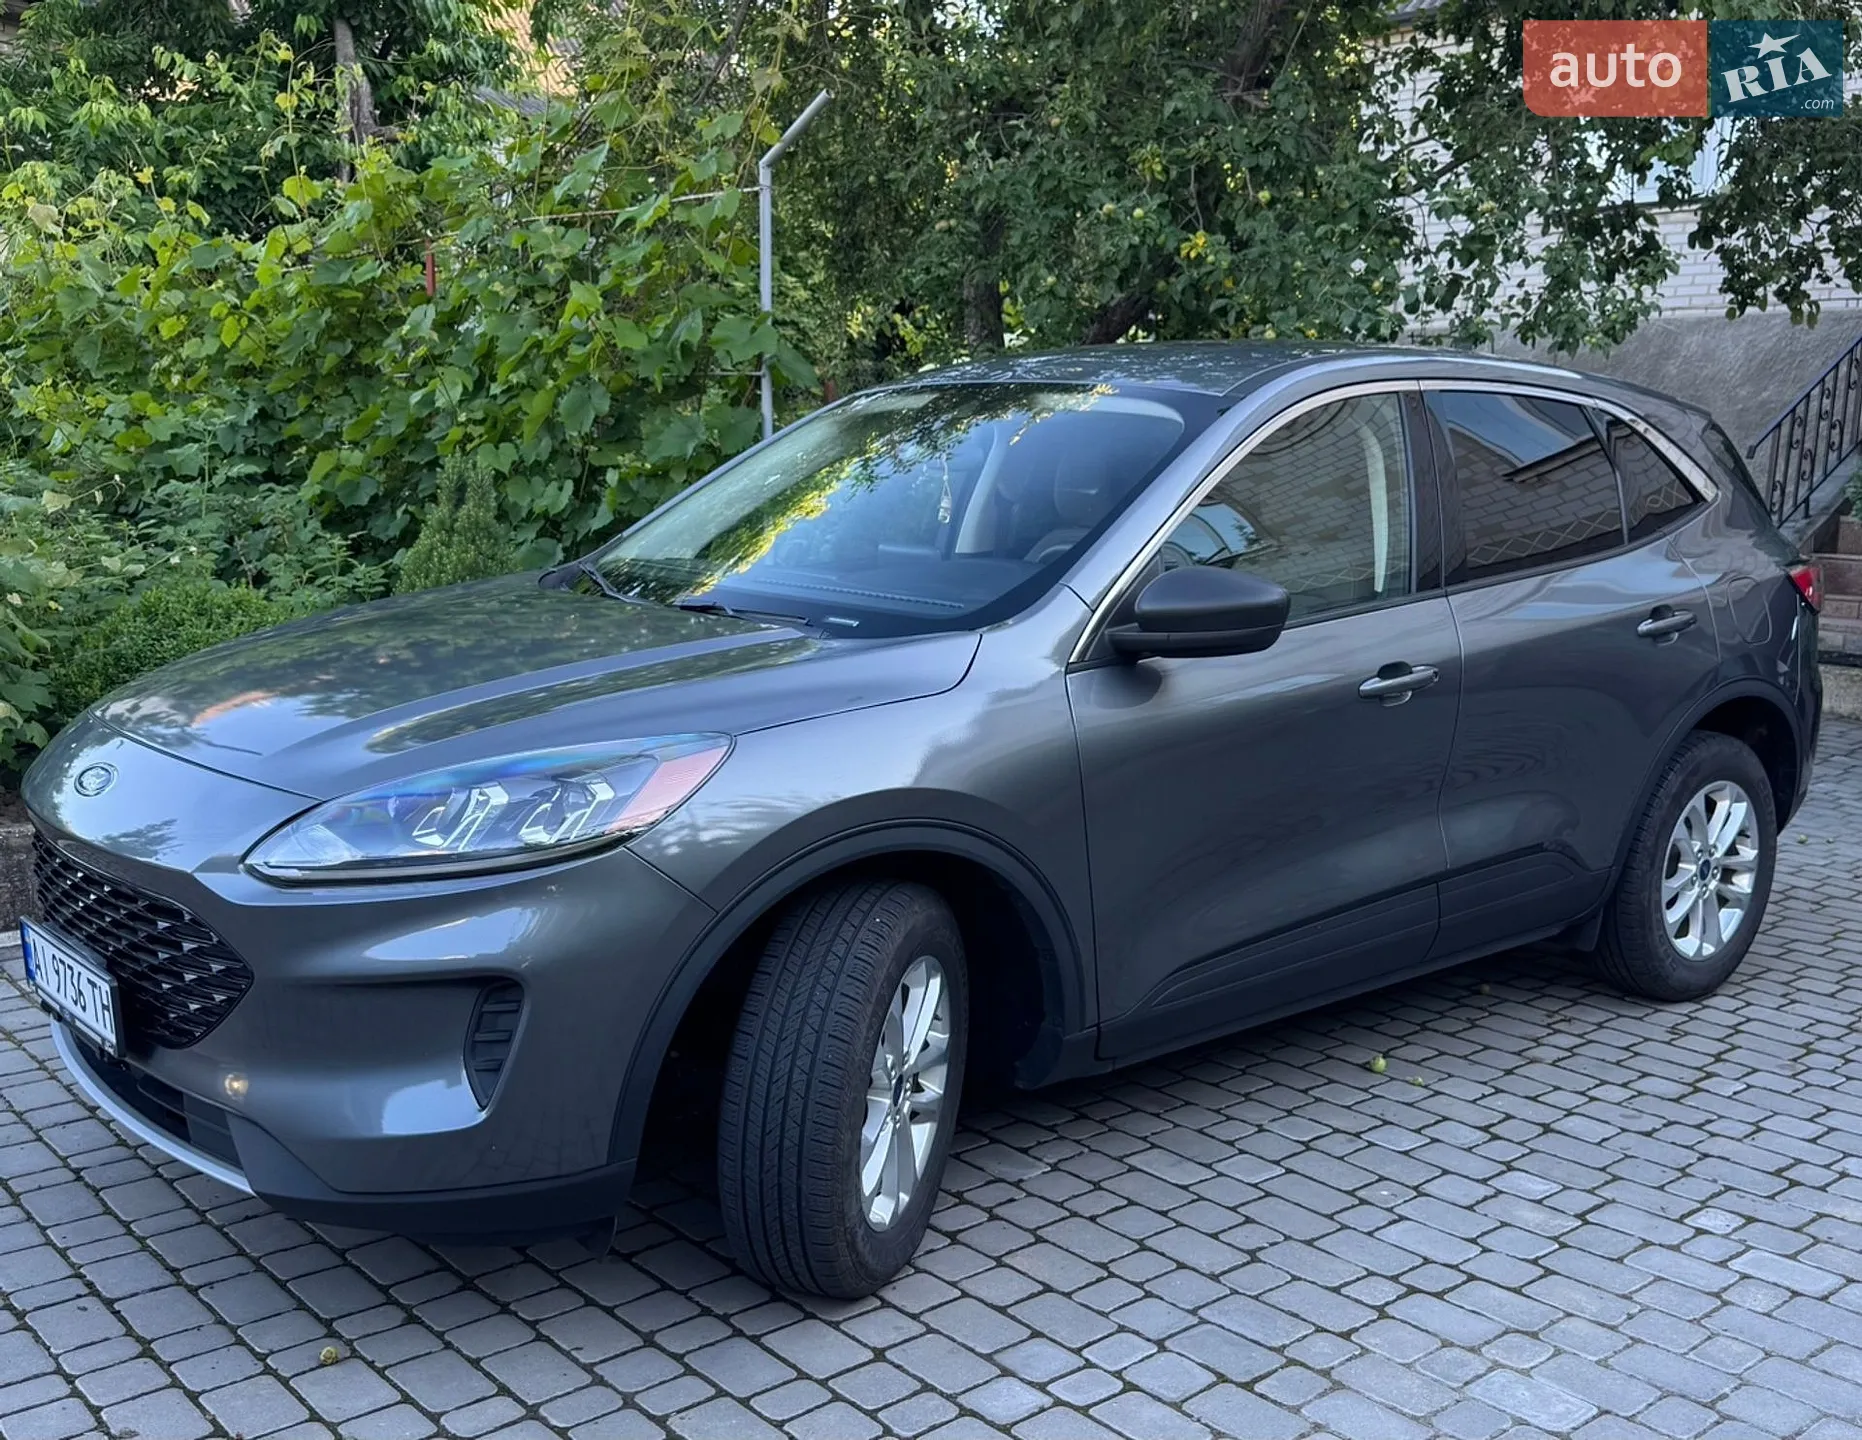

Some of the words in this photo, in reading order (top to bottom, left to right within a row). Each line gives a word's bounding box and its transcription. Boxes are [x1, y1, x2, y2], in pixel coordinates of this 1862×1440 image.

[33, 938, 50, 986] AI
[52, 953, 87, 1013] 9736
[87, 977, 114, 1034] TH
